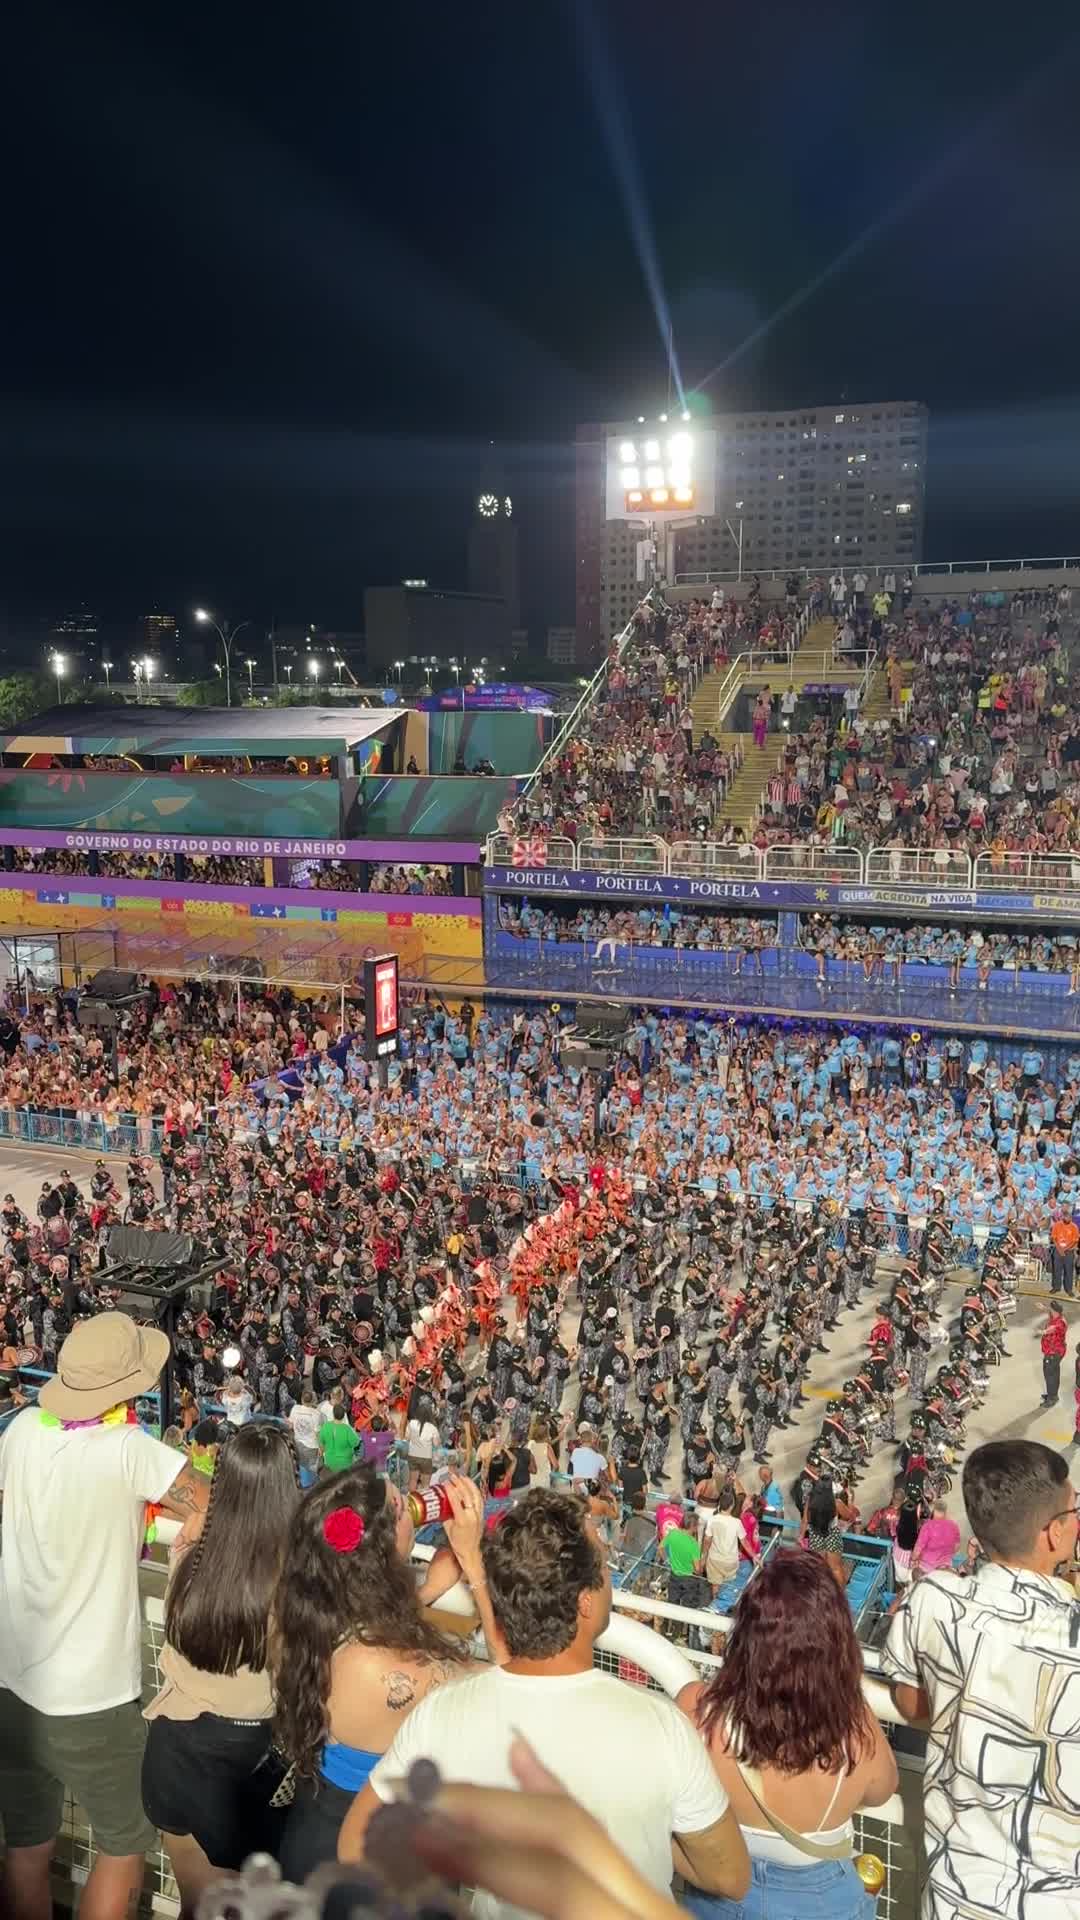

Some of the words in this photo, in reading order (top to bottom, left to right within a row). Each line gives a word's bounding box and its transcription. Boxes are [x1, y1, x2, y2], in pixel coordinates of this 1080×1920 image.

[66, 835, 129, 848] GOVERNO
[133, 838, 152, 849] DO
[156, 839, 208, 851] ESTADO
[212, 840, 231, 852] DO
[236, 841, 259, 852] RIO
[264, 841, 280, 853] DE
[284, 843, 346, 855] JANEIRO
[506, 871, 570, 887] PORTELA
[596, 876, 663, 892] PORTELA
[690, 881, 760, 898] PORTELA
[842, 890, 874, 900] QUEM
[875, 892, 927, 904] ACREDITA
[930, 895, 946, 903] NA
[948, 894, 973, 904] VIDA
